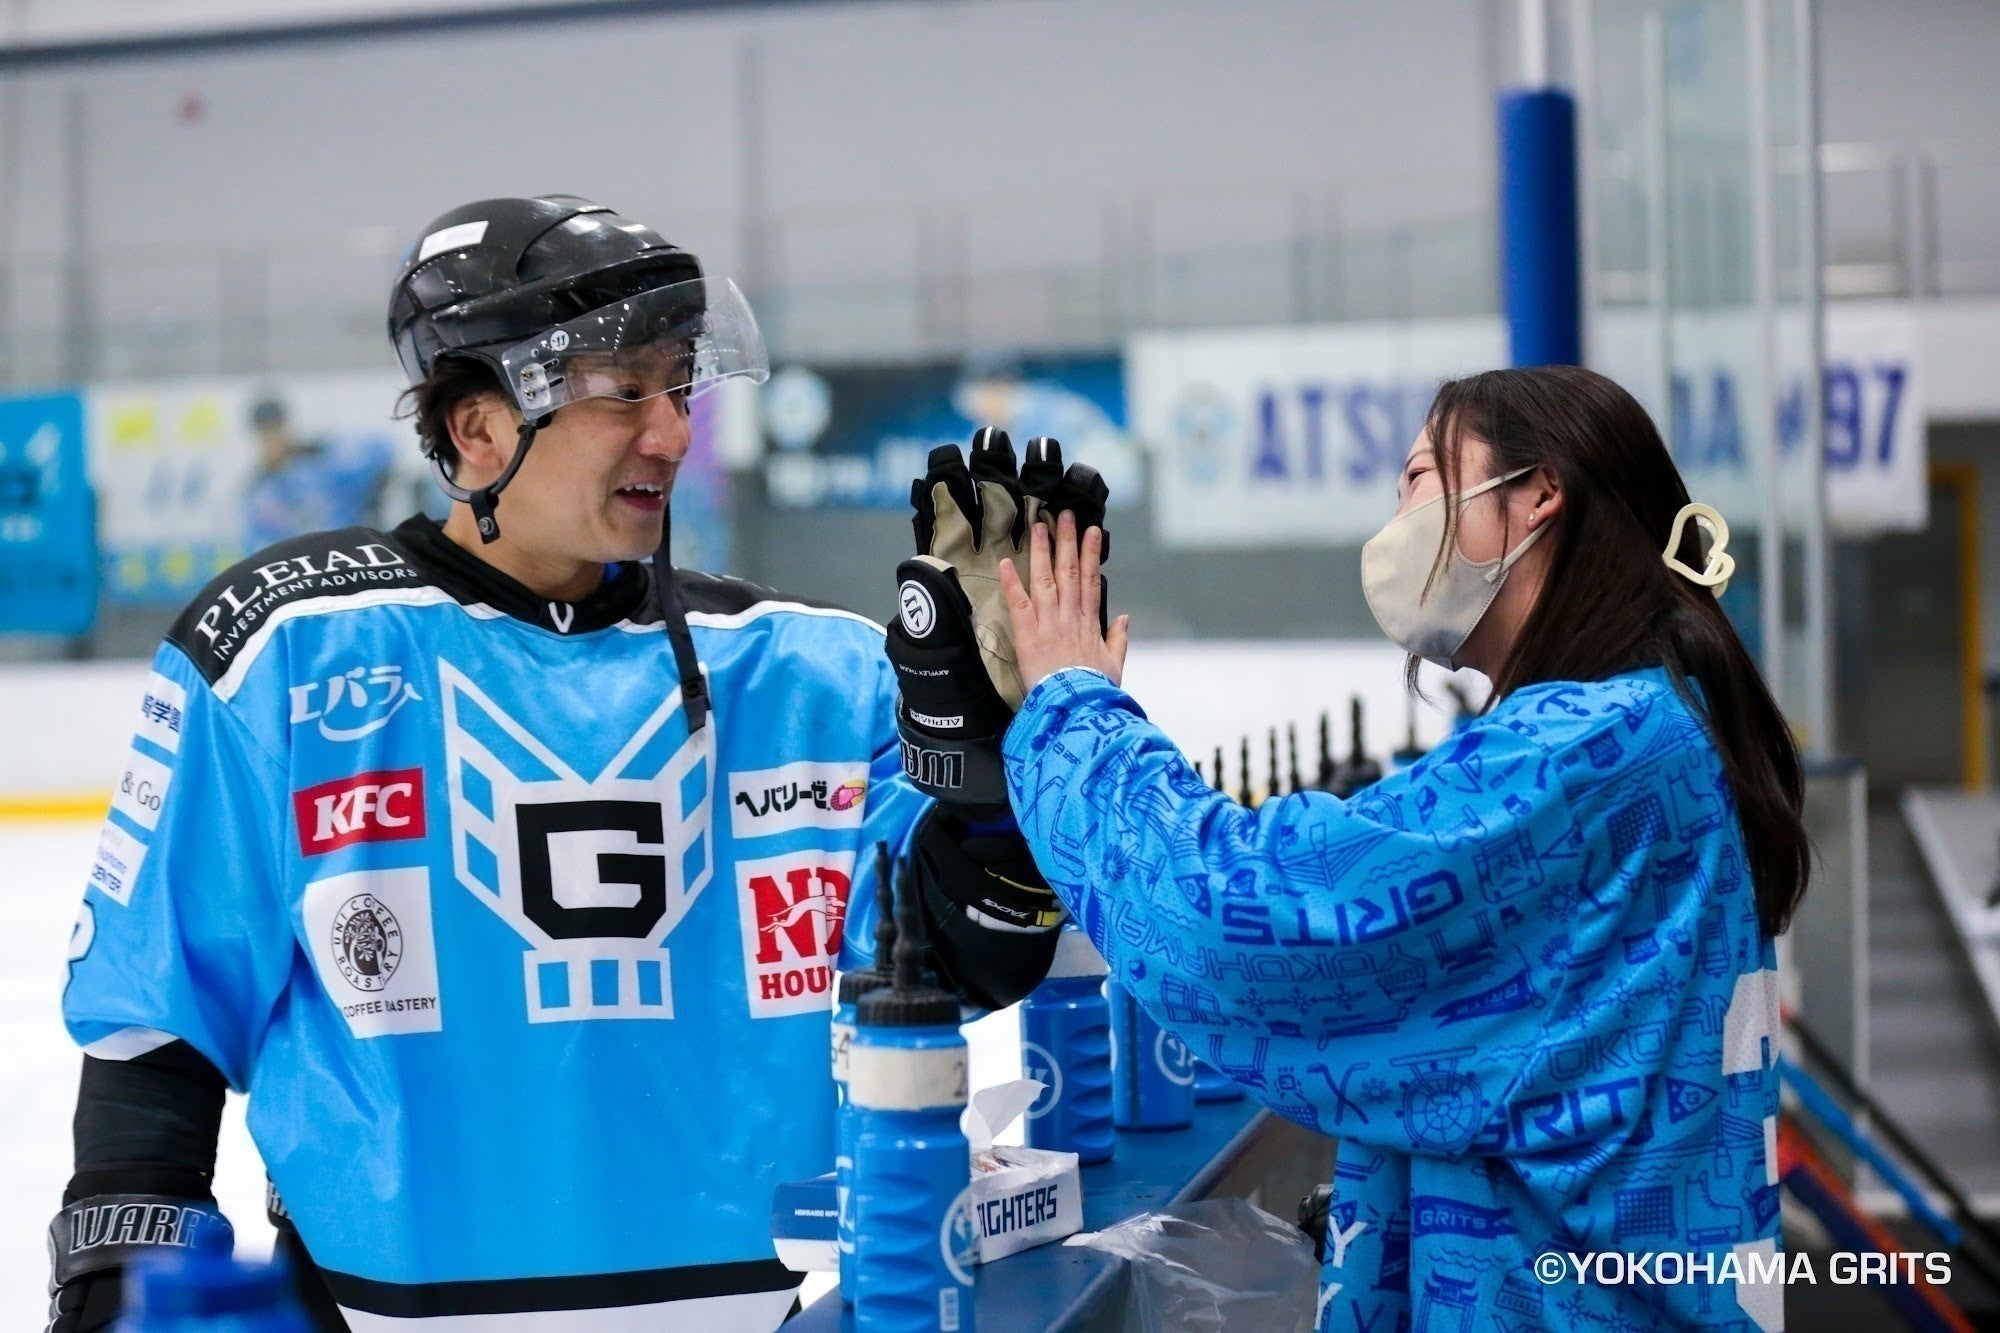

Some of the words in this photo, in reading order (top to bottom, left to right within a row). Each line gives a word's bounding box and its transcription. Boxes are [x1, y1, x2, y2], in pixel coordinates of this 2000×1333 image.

[195, 543, 405, 646] PLEIAD
[213, 579, 313, 661] INVESTMENT
[320, 568, 418, 587] ADVISORS
[289, 666, 420, 738] エバラ
[312, 783, 413, 841] KFC
[735, 780, 832, 818] ヘパリーゼ
[515, 800, 666, 940] G
[1115, 902, 1423, 983] YOKOHAMA
[1222, 869, 1464, 947] GRITS
[760, 965, 834, 1000] HOU
[1420, 1209, 1487, 1229] GRITS
